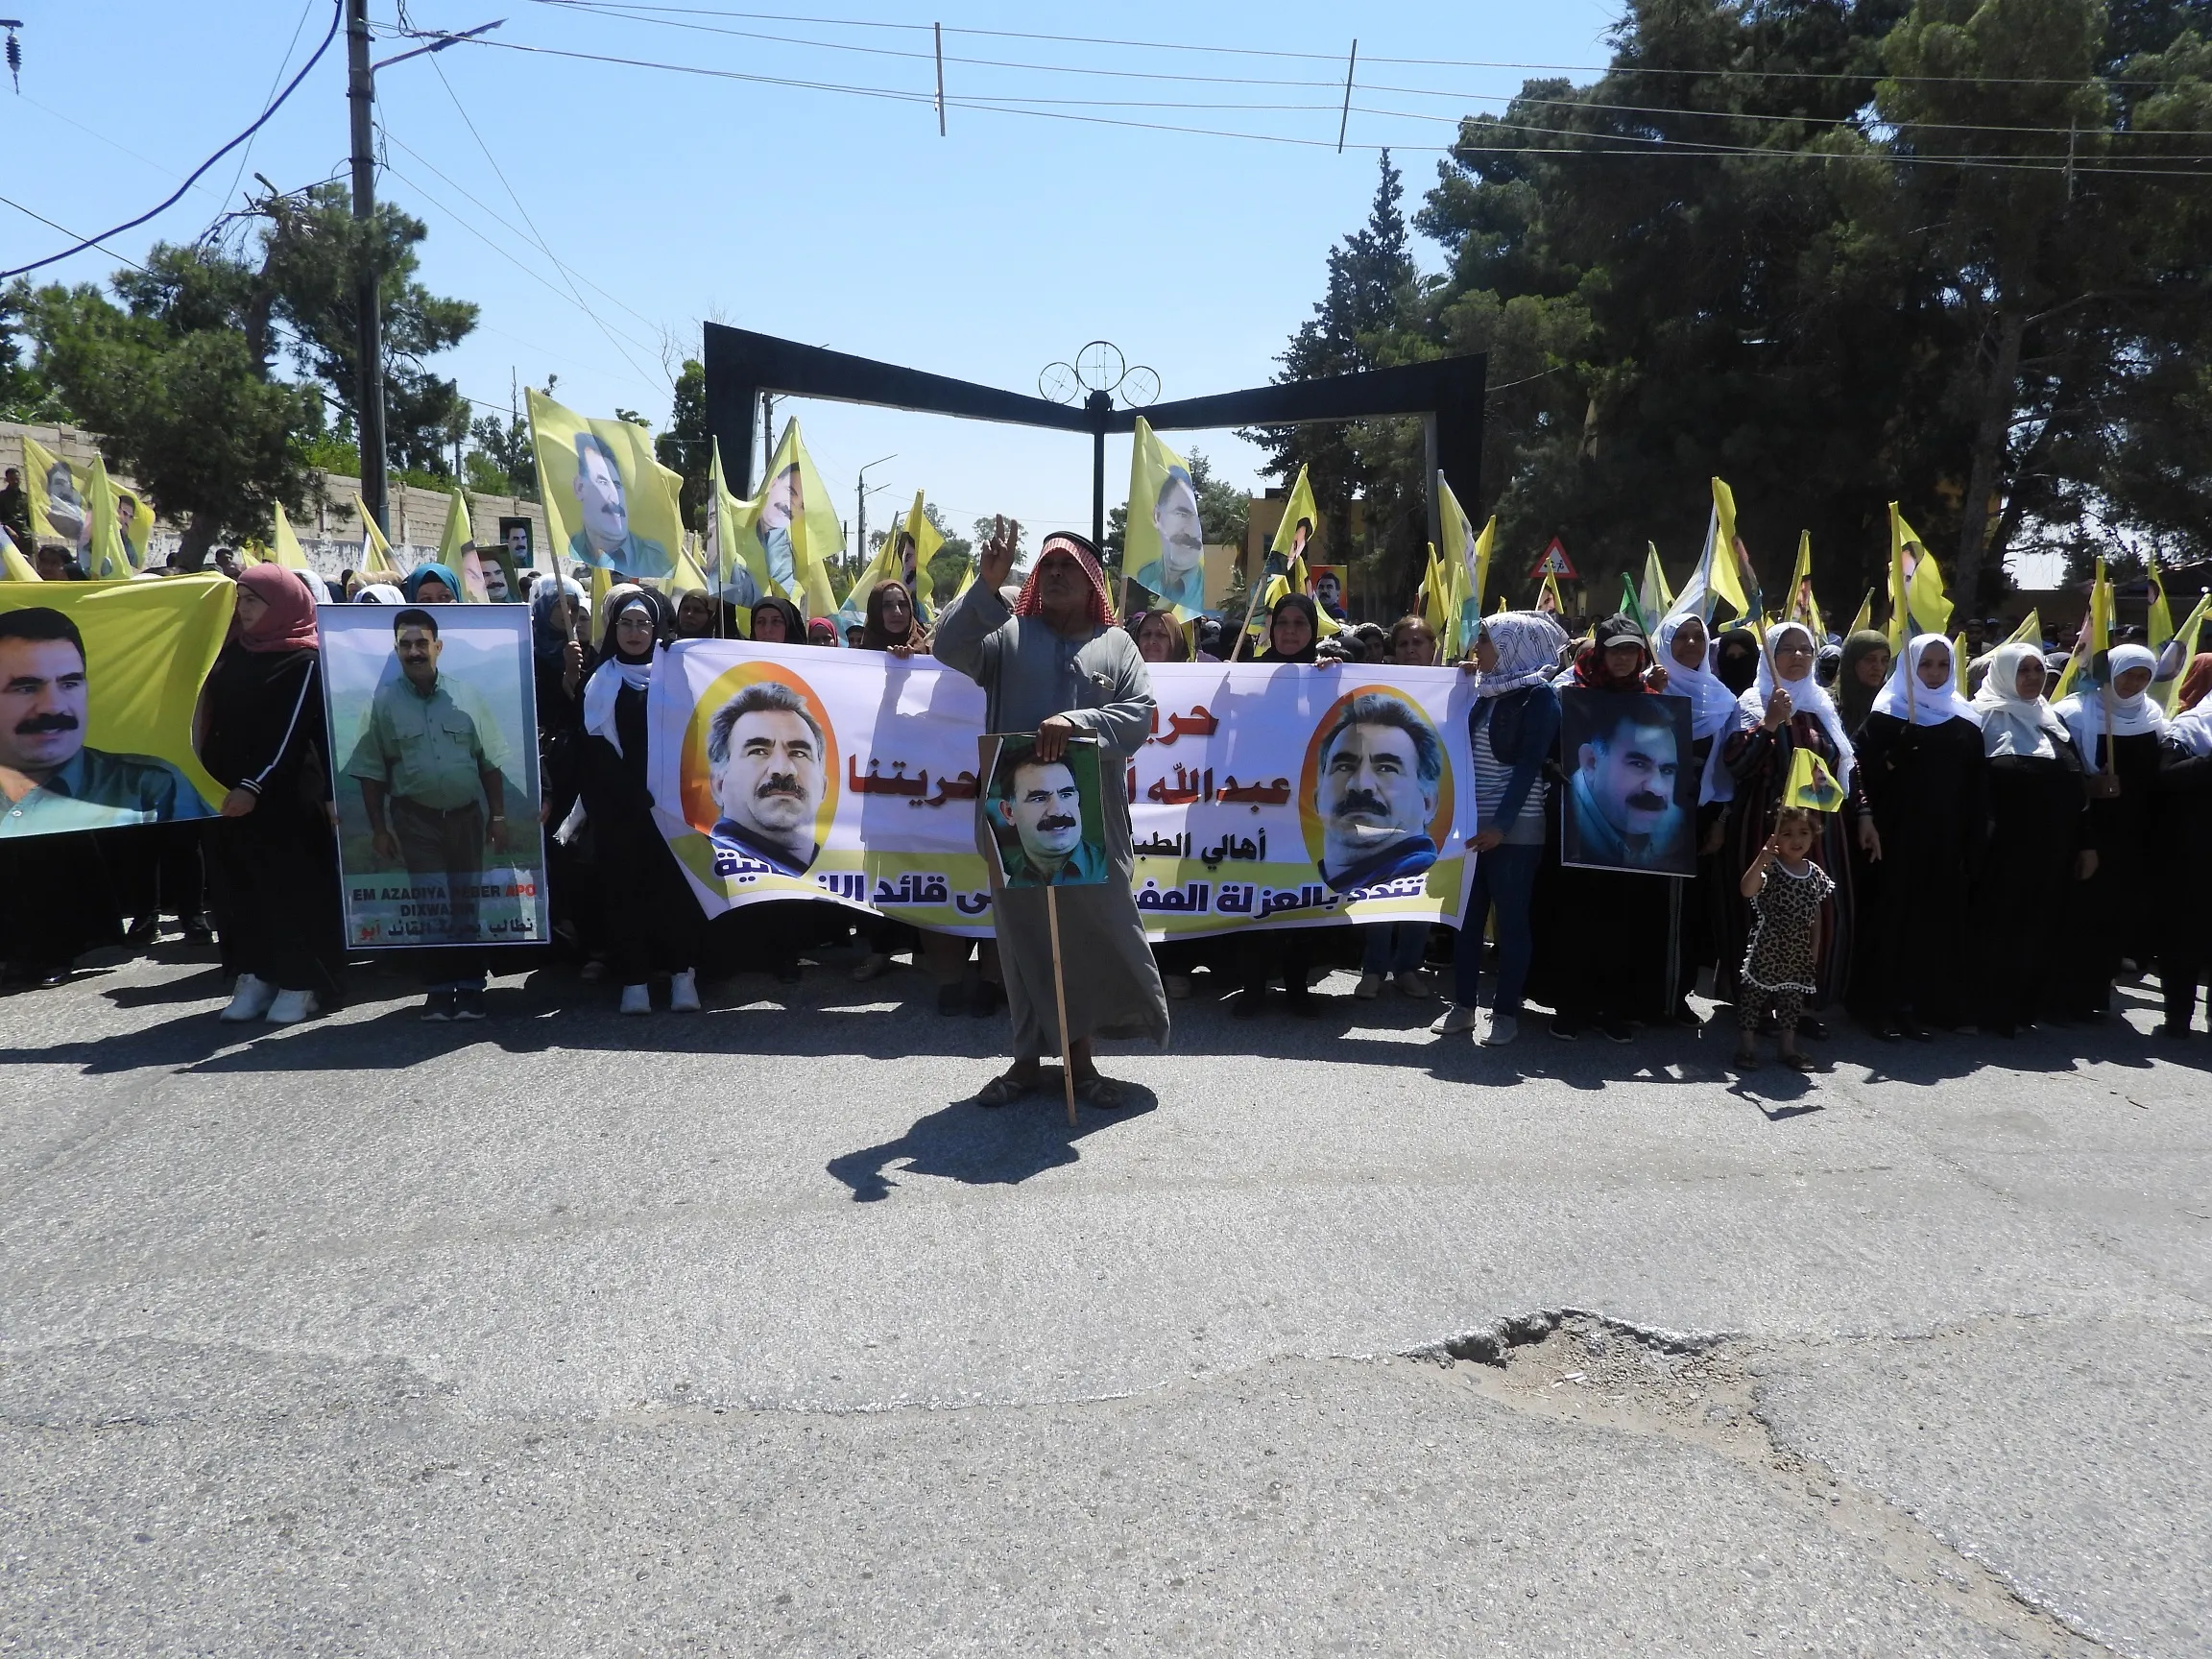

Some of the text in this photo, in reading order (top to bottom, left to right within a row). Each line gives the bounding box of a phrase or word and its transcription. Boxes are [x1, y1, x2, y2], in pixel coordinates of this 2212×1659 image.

[1132, 827, 1266, 872] أهالي الطب
[352, 889, 376, 902] EM
[381, 887, 446, 901] AZADIYA
[505, 883, 537, 897] APO
[874, 875, 948, 903] قائد
[1215, 884, 1339, 919] بالعزلة
[489, 917, 533, 938] نطالب
